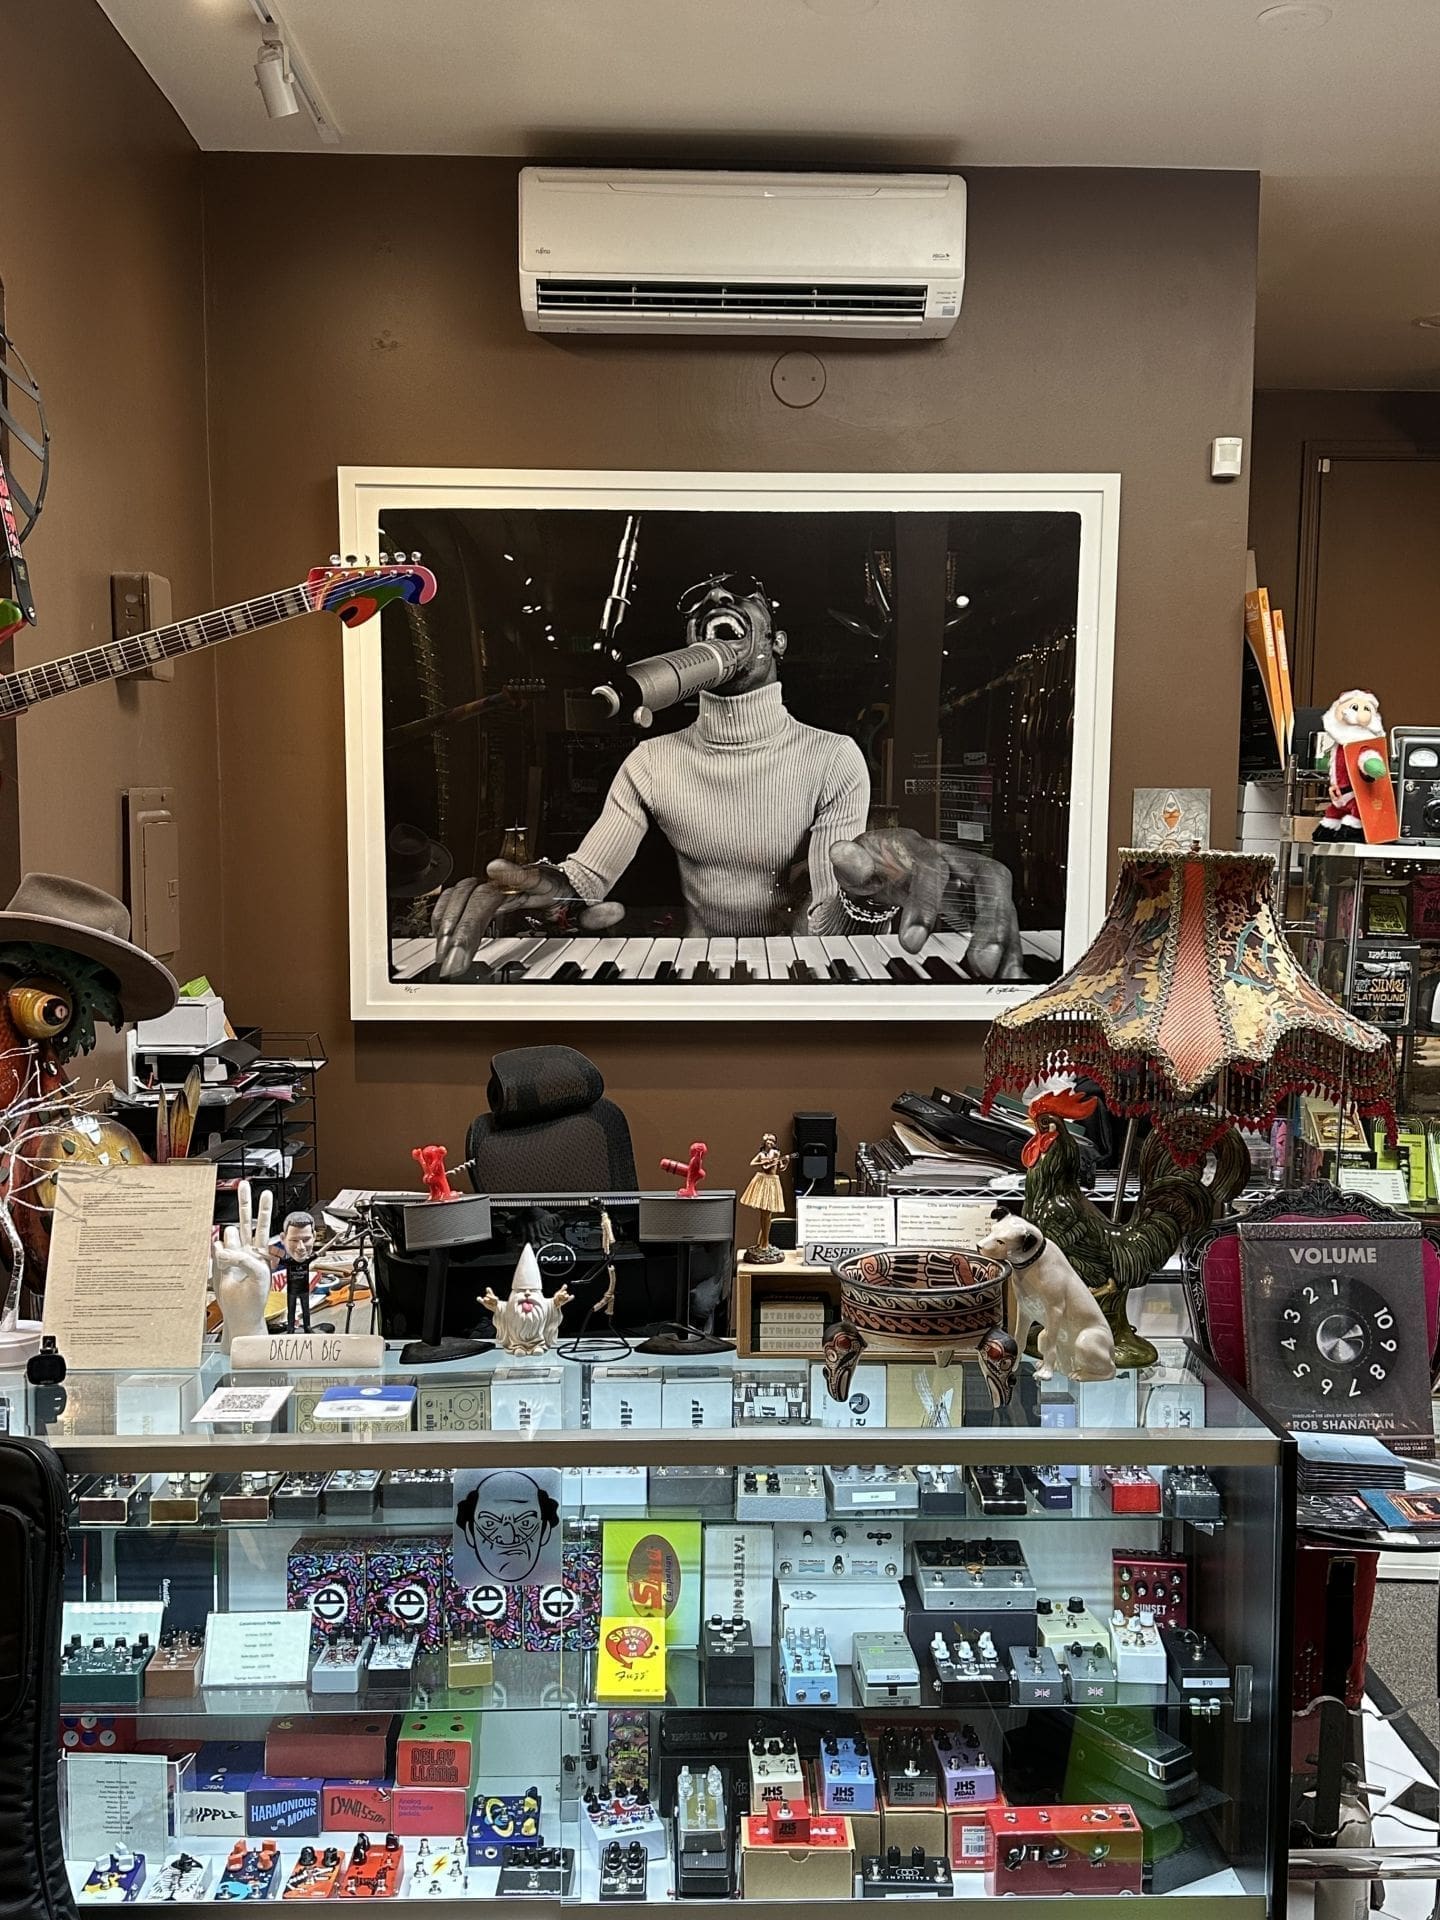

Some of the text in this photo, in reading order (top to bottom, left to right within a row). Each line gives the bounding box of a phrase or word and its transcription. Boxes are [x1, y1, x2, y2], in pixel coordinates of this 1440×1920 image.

[1370, 978, 1407, 993] SLINKY
[1289, 1247, 1377, 1264] VOLUME
[1331, 1279, 1338, 1295] 1
[1303, 1287, 1319, 1304] 2
[763, 1312, 822, 1320] STRINGJOY
[1284, 1309, 1300, 1323] 3
[1374, 1307, 1393, 1329] 10
[762, 1327, 821, 1335] STRINGJOY
[270, 1340, 342, 1361] DREAM BIG
[762, 1341, 821, 1349] STRINGJOY
[1281, 1337, 1297, 1350] 4
[1380, 1339, 1397, 1352] 9
[1293, 1363, 1310, 1378] 5
[1370, 1364, 1386, 1380] 8
[1321, 1379, 1333, 1395] 6
[1349, 1378, 1361, 1397] 7
[1293, 1419, 1395, 1431] ROB SHANAHAN
[1133, 1603, 1167, 1615] SUNSET
[608, 1627, 649, 1643] SPECIAL
[615, 1670, 648, 1682] Fuzz
[411, 1747, 456, 1765] DELAY
[410, 1764, 459, 1783] LLAMA
[762, 1786, 783, 1796] JHS
[833, 1787, 854, 1796] JHS
[894, 1782, 915, 1791] JHS
[954, 1780, 976, 1791] JHS
[251, 1798, 317, 1822] HARMONIOUS
[287, 1807, 317, 1827] MONK
[779, 1822, 797, 1830] JHS
